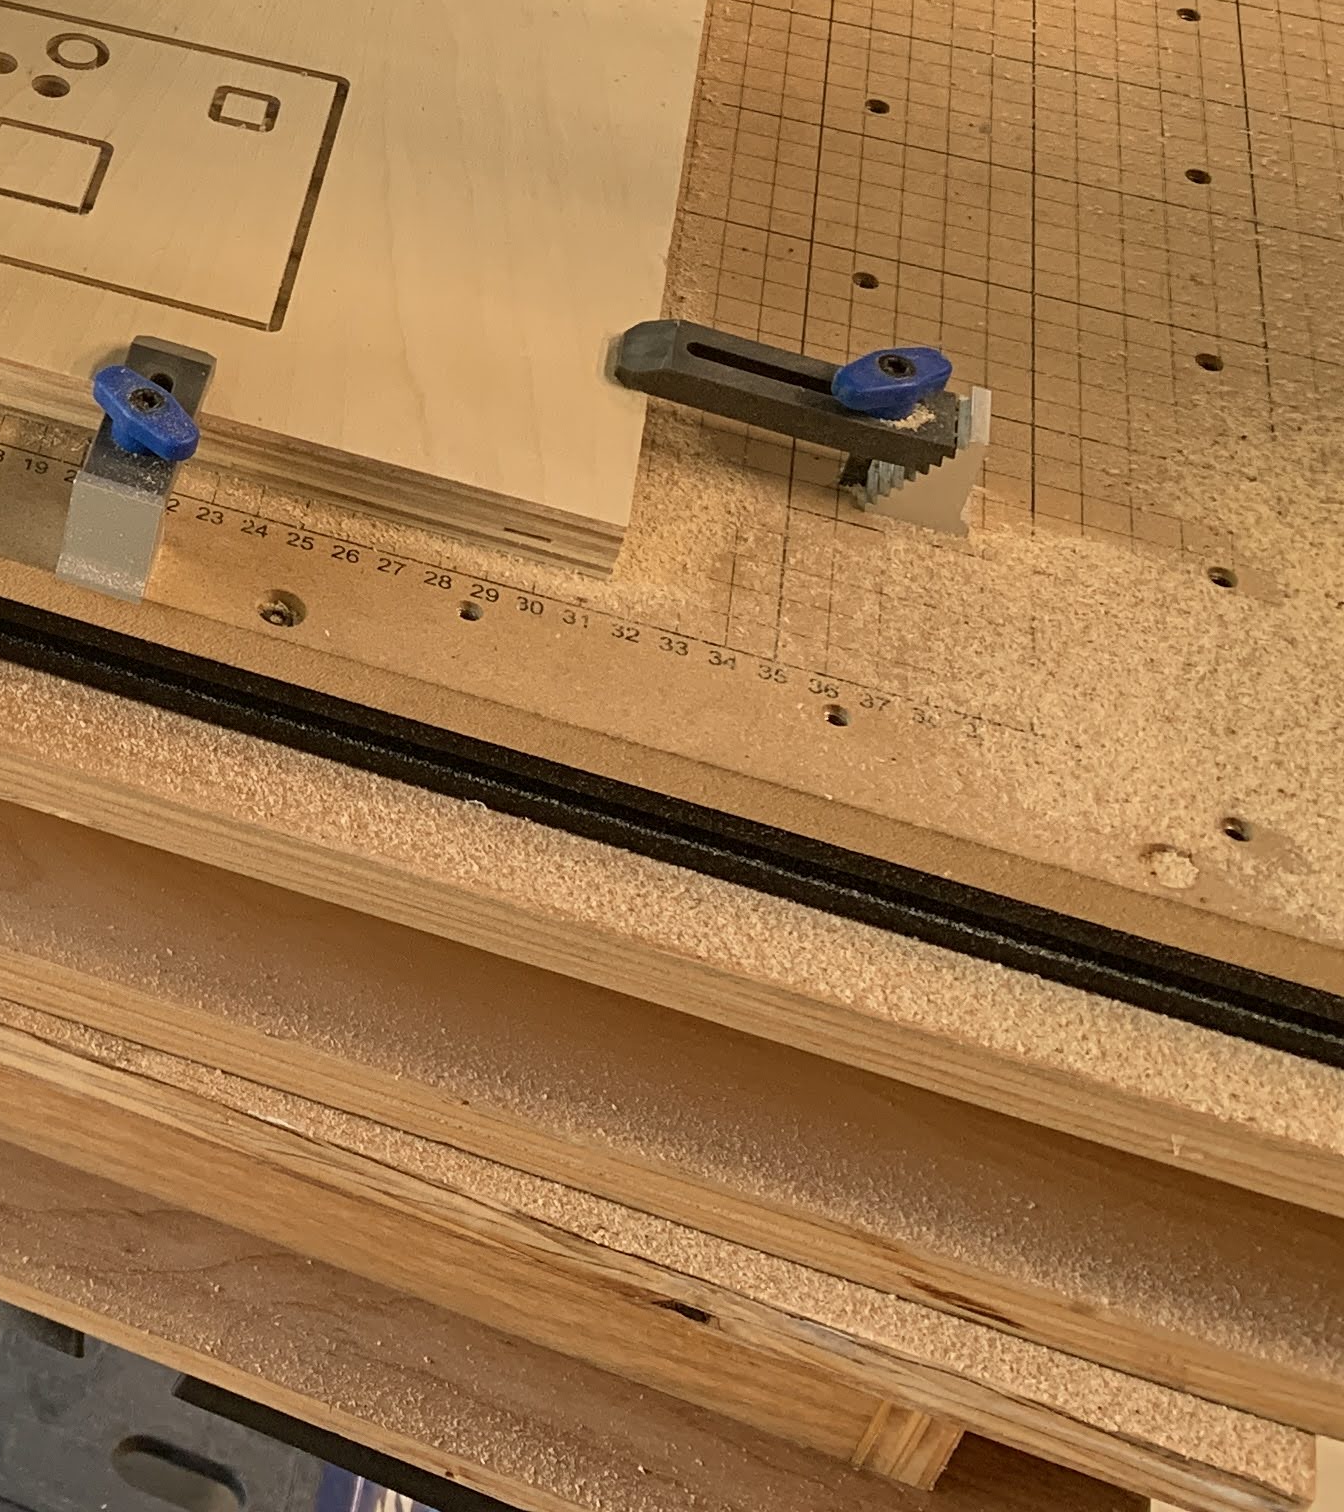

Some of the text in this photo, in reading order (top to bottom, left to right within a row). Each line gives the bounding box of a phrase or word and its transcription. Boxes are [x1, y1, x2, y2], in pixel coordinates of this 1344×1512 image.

[23, 458, 49, 475] 19
[195, 506, 224, 526] 23
[240, 518, 268, 539] 24
[285, 531, 314, 551] 25
[331, 544, 360, 564] 26
[376, 557, 407, 576] 27
[422, 570, 453, 589] 28
[469, 583, 500, 603] 29
[515, 596, 544, 616] 30
[562, 609, 589, 628] 31
[611, 622, 641, 644] 32
[658, 636, 689, 656] 33
[708, 650, 737, 670] 34
[757, 663, 788, 684] 35
[807, 678, 841, 699] 36
[859, 693, 891, 712] 37
